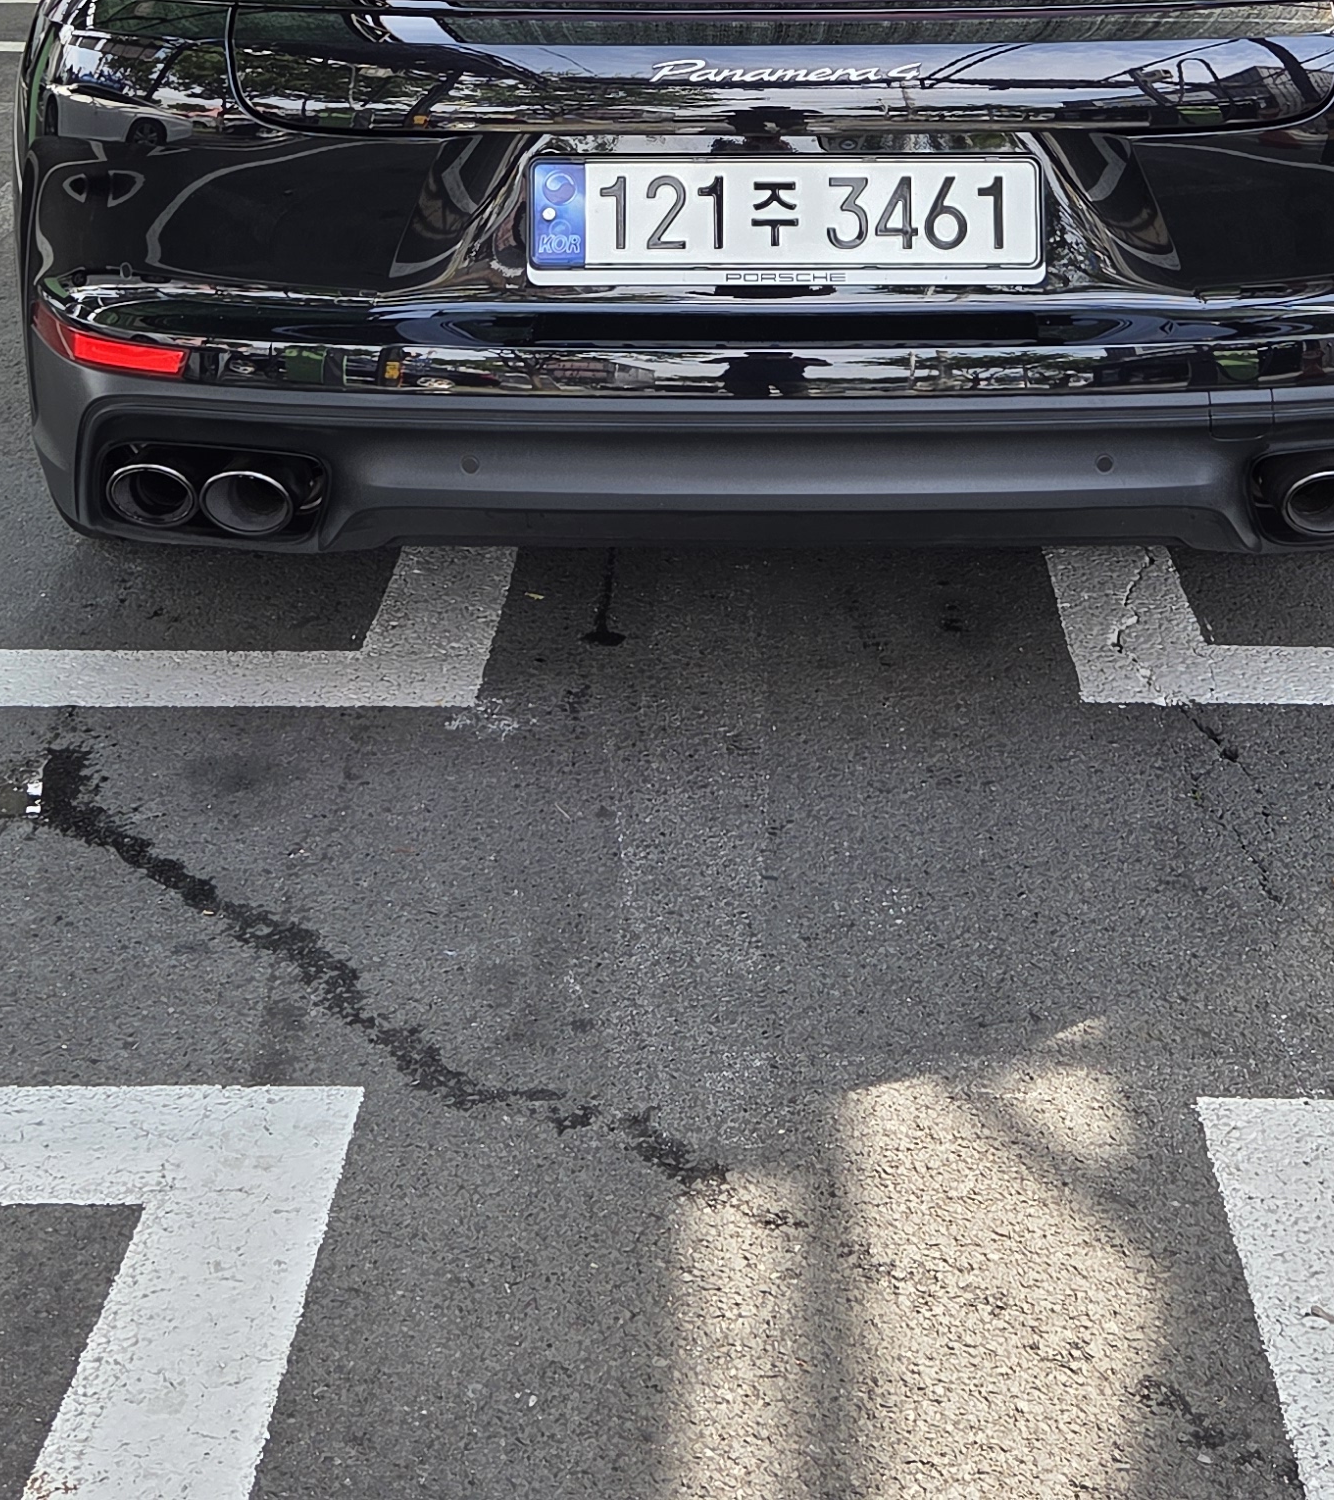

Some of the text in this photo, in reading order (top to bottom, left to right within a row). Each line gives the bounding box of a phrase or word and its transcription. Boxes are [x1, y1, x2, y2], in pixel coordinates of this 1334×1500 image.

[649, 59, 922, 83] Panamera 4
[599, 176, 1005, 251] 121주 3461
[538, 234, 581, 254] KOR
[725, 272, 847, 283] PORSCHE
